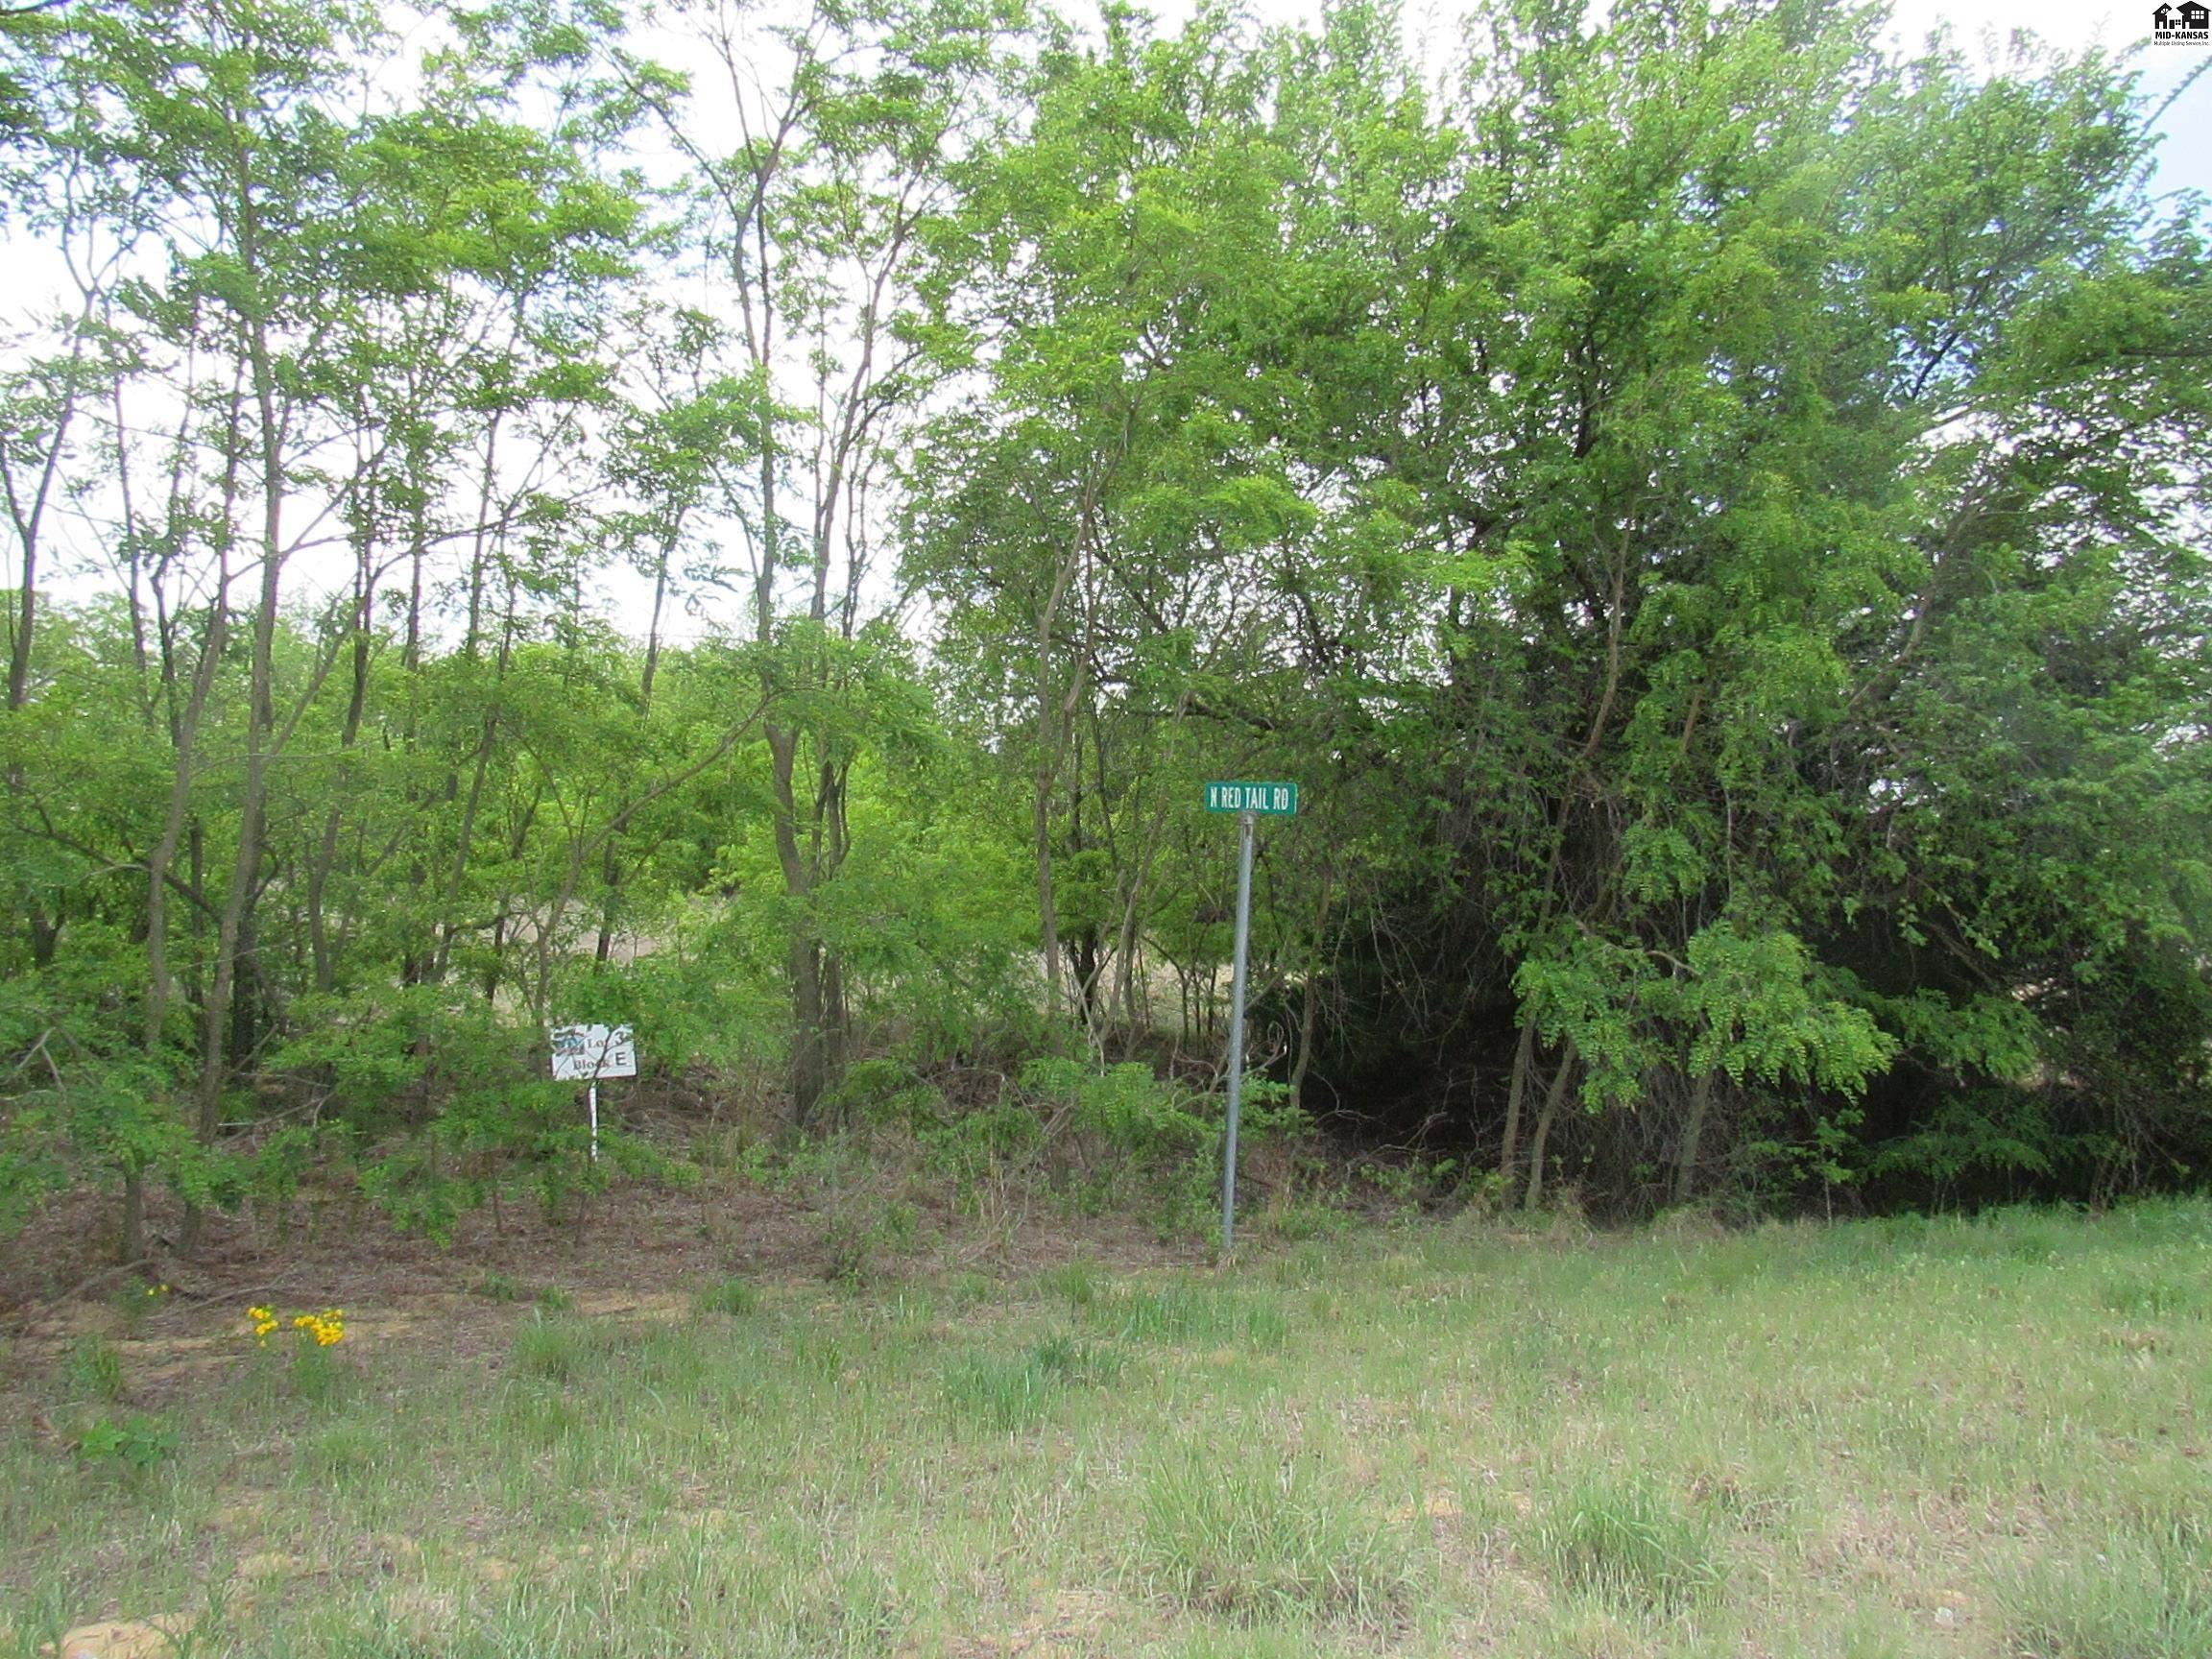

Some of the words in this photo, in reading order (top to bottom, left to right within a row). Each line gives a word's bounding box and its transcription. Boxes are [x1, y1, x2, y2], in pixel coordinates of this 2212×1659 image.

[1210, 786, 1217, 807] N
[1221, 786, 1241, 808] RED
[1244, 787, 1269, 809] TAIL
[1273, 787, 1288, 810] RD
[587, 1039, 609, 1049] Lo
[614, 1031, 625, 1046] 3
[615, 1051, 627, 1066] E
